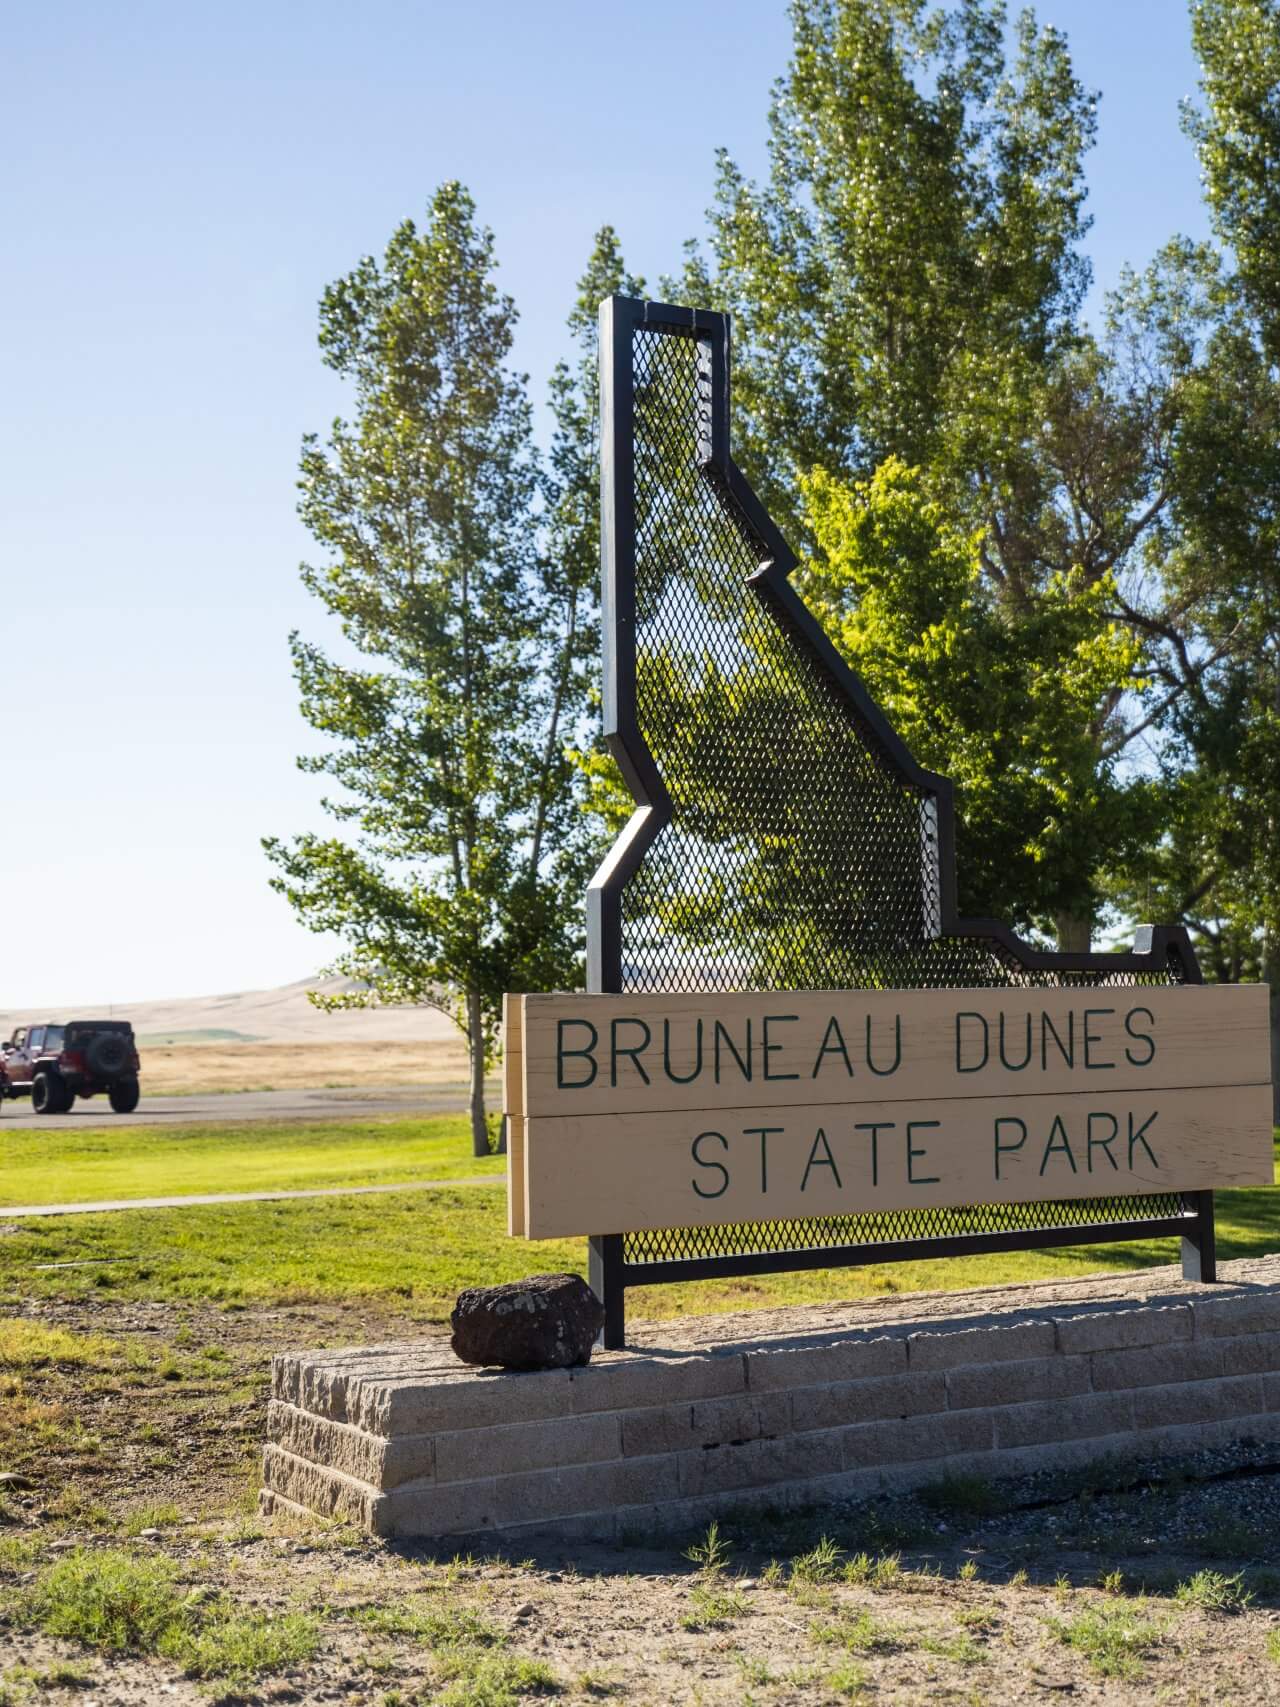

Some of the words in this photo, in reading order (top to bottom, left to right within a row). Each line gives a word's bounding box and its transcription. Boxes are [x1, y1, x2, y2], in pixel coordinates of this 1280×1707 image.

[557, 1014, 902, 1090] BRUNEAU
[955, 1007, 1156, 1074] DUNES
[691, 1120, 941, 1199] STATE
[994, 1111, 1163, 1182] PARK
